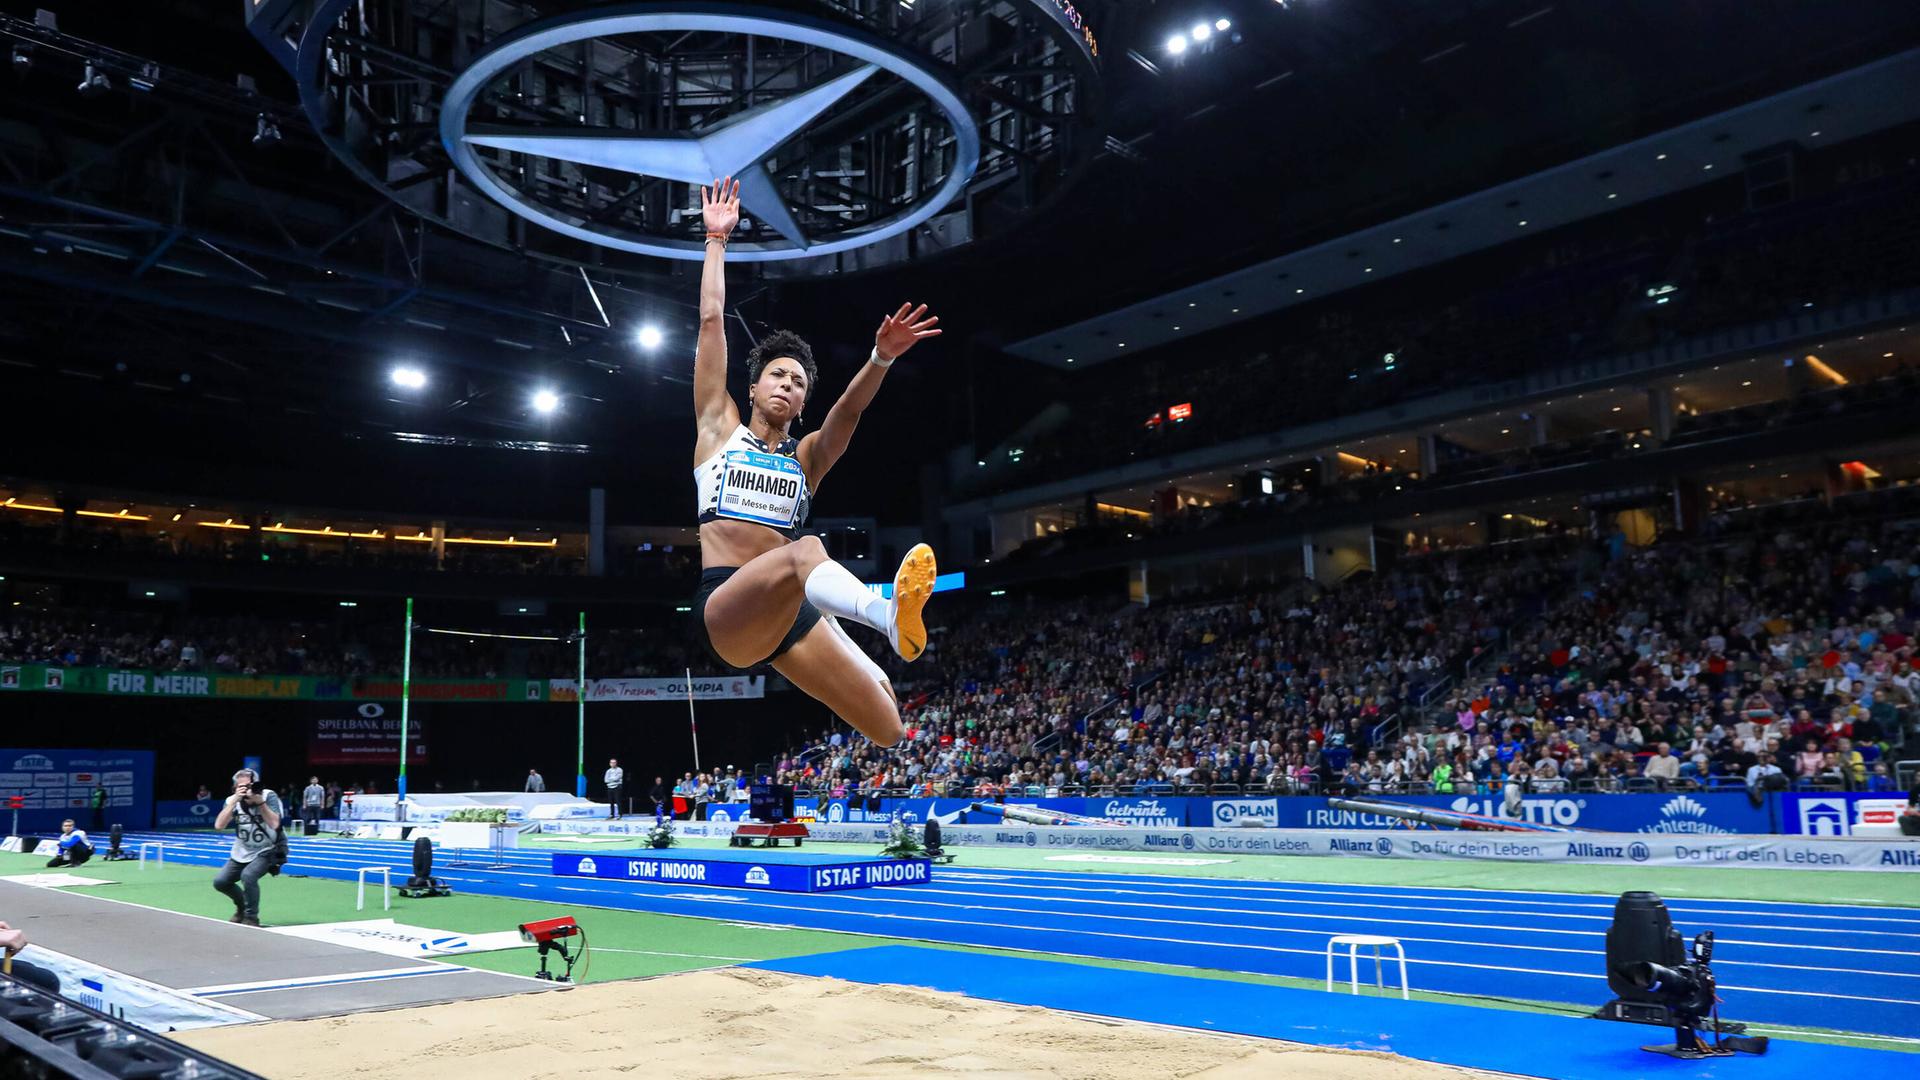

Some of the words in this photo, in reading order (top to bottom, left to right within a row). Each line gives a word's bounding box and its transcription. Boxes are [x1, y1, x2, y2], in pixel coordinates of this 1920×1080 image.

[727, 469, 798, 499] MIHAMBO
[741, 498, 768, 511] Messe
[768, 503, 791, 515] Berlin
[107, 670, 146, 693] FÜR
[153, 675, 209, 695] MEHR
[215, 677, 301, 697] FAIRPLAY
[618, 681, 658, 697] Traum
[666, 683, 724, 694] OLYMPIA
[317, 719, 380, 730] SPIELBANK
[382, 719, 422, 731] BEIN
[1105, 800, 1167, 817] Getränke
[1239, 805, 1275, 817] PLAN
[1316, 809, 1357, 826] RUN
[996, 832, 1024, 843] Allianz
[1048, 834, 1062, 845] Da
[1063, 834, 1076, 845] für
[1078, 834, 1098, 845] dein
[1144, 835, 1180, 847] Allianz
[1209, 836, 1225, 848] Da
[1227, 836, 1243, 849] für
[1246, 837, 1270, 849] dein
[1273, 838, 1312, 851] Leben.
[1330, 838, 1373, 852] Allianz
[1412, 840, 1432, 854] Da
[1434, 840, 1454, 854] für
[1458, 842, 1490, 855] dein
[1494, 842, 1544, 857] Leben.
[1567, 842, 1624, 858] Allianz
[1675, 845, 1701, 860] Da
[1706, 846, 1731, 861] für
[1736, 846, 1777, 862] dein
[1784, 848, 1850, 865] Leben.
[628, 860, 659, 878] ISTAF
[661, 862, 706, 880] INDOOR
[816, 867, 861, 887] ISTAF
[866, 863, 926, 883] INDOOR
